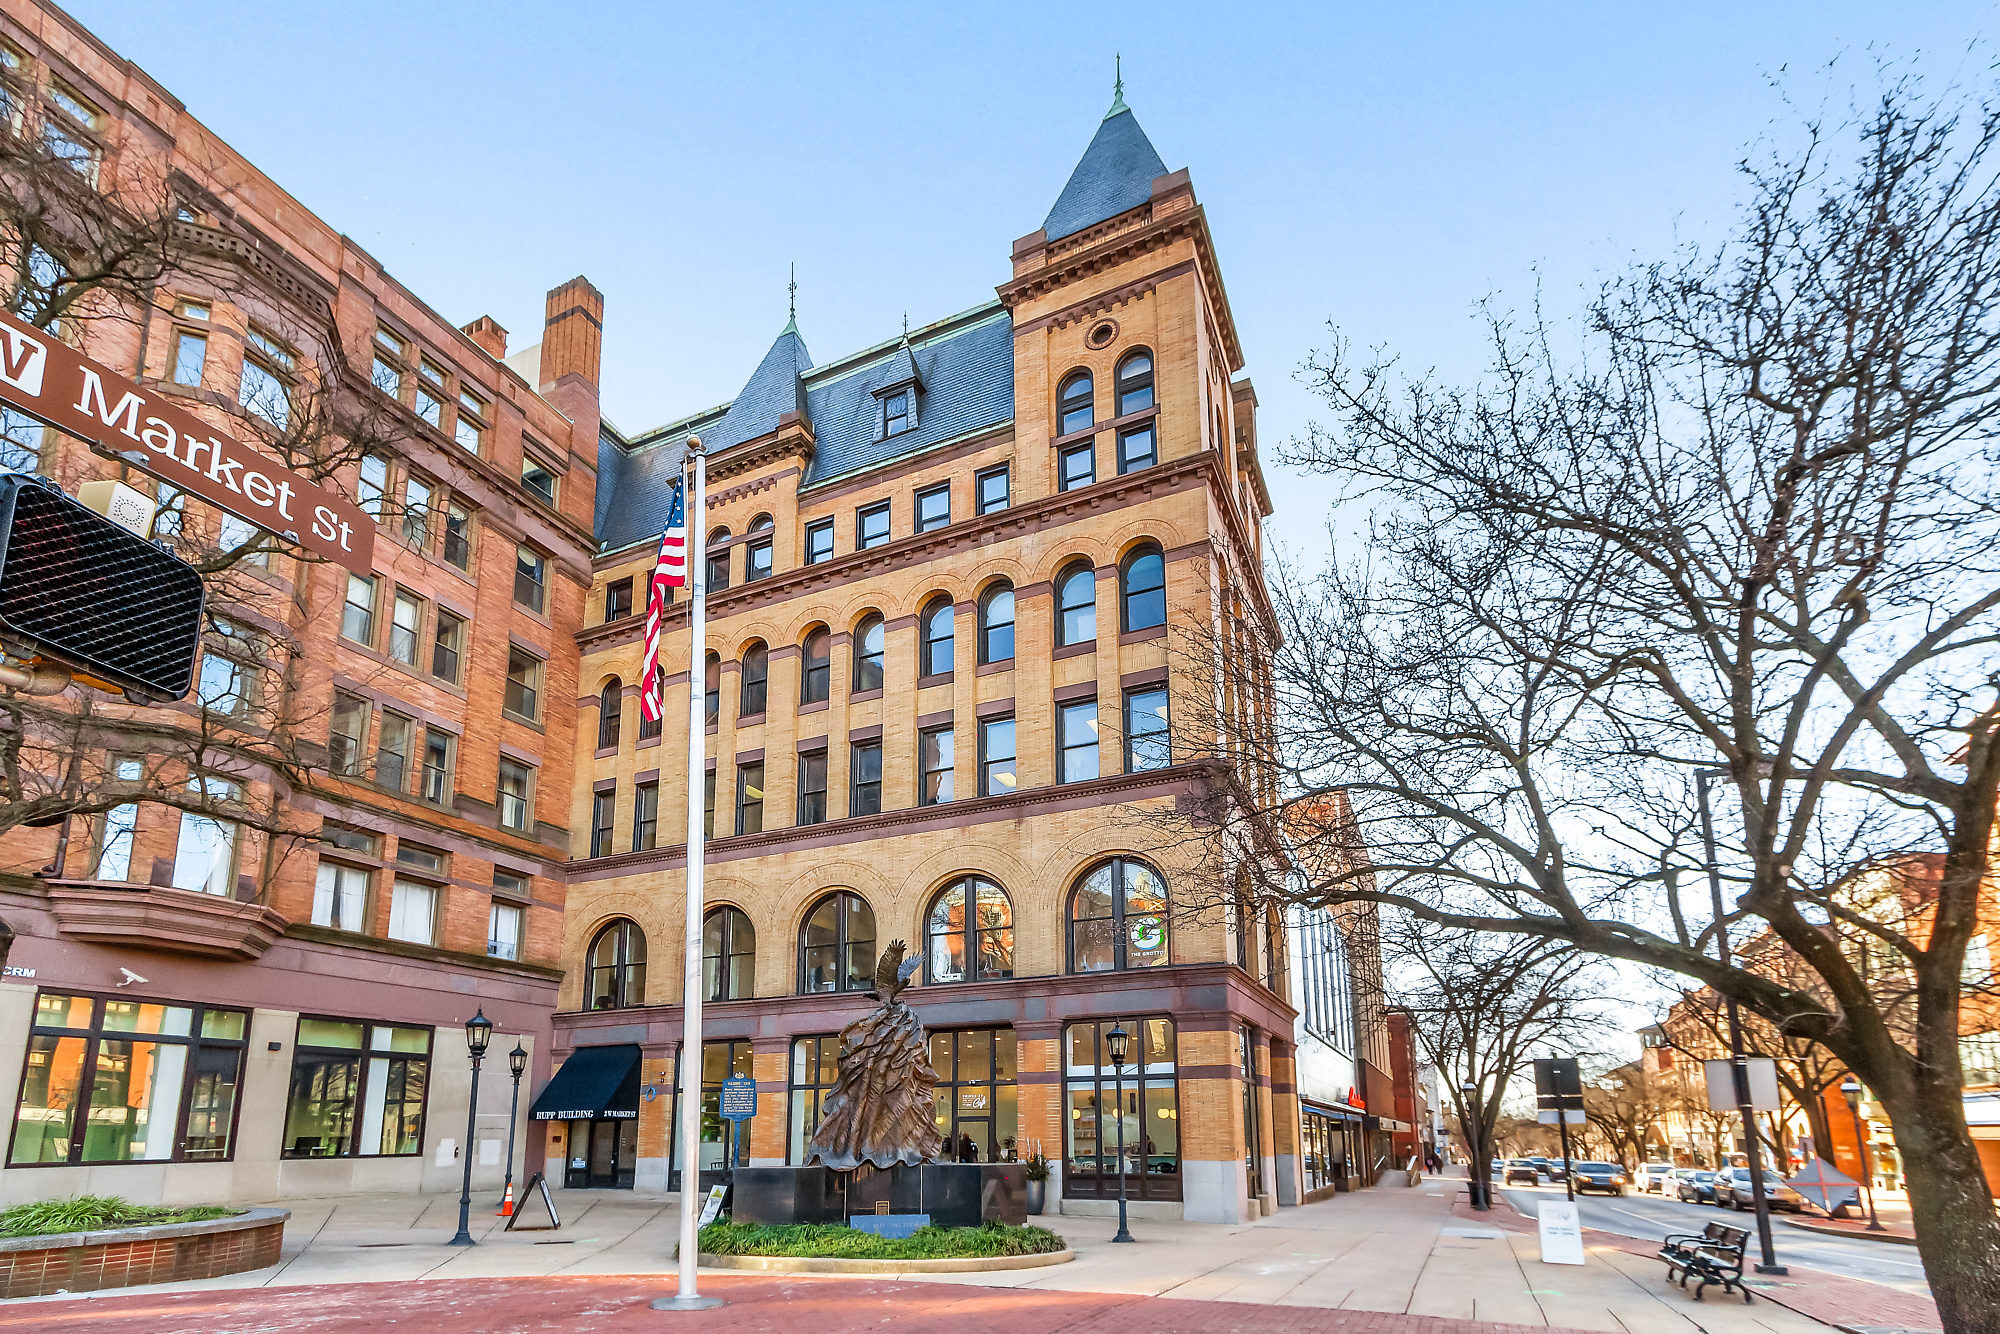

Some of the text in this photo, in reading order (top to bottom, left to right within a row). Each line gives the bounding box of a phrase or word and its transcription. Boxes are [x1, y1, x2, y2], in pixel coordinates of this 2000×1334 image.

[72, 364, 296, 523] Market
[311, 504, 355, 554] St
[536, 1109, 594, 1120] RUPP BUILDING
